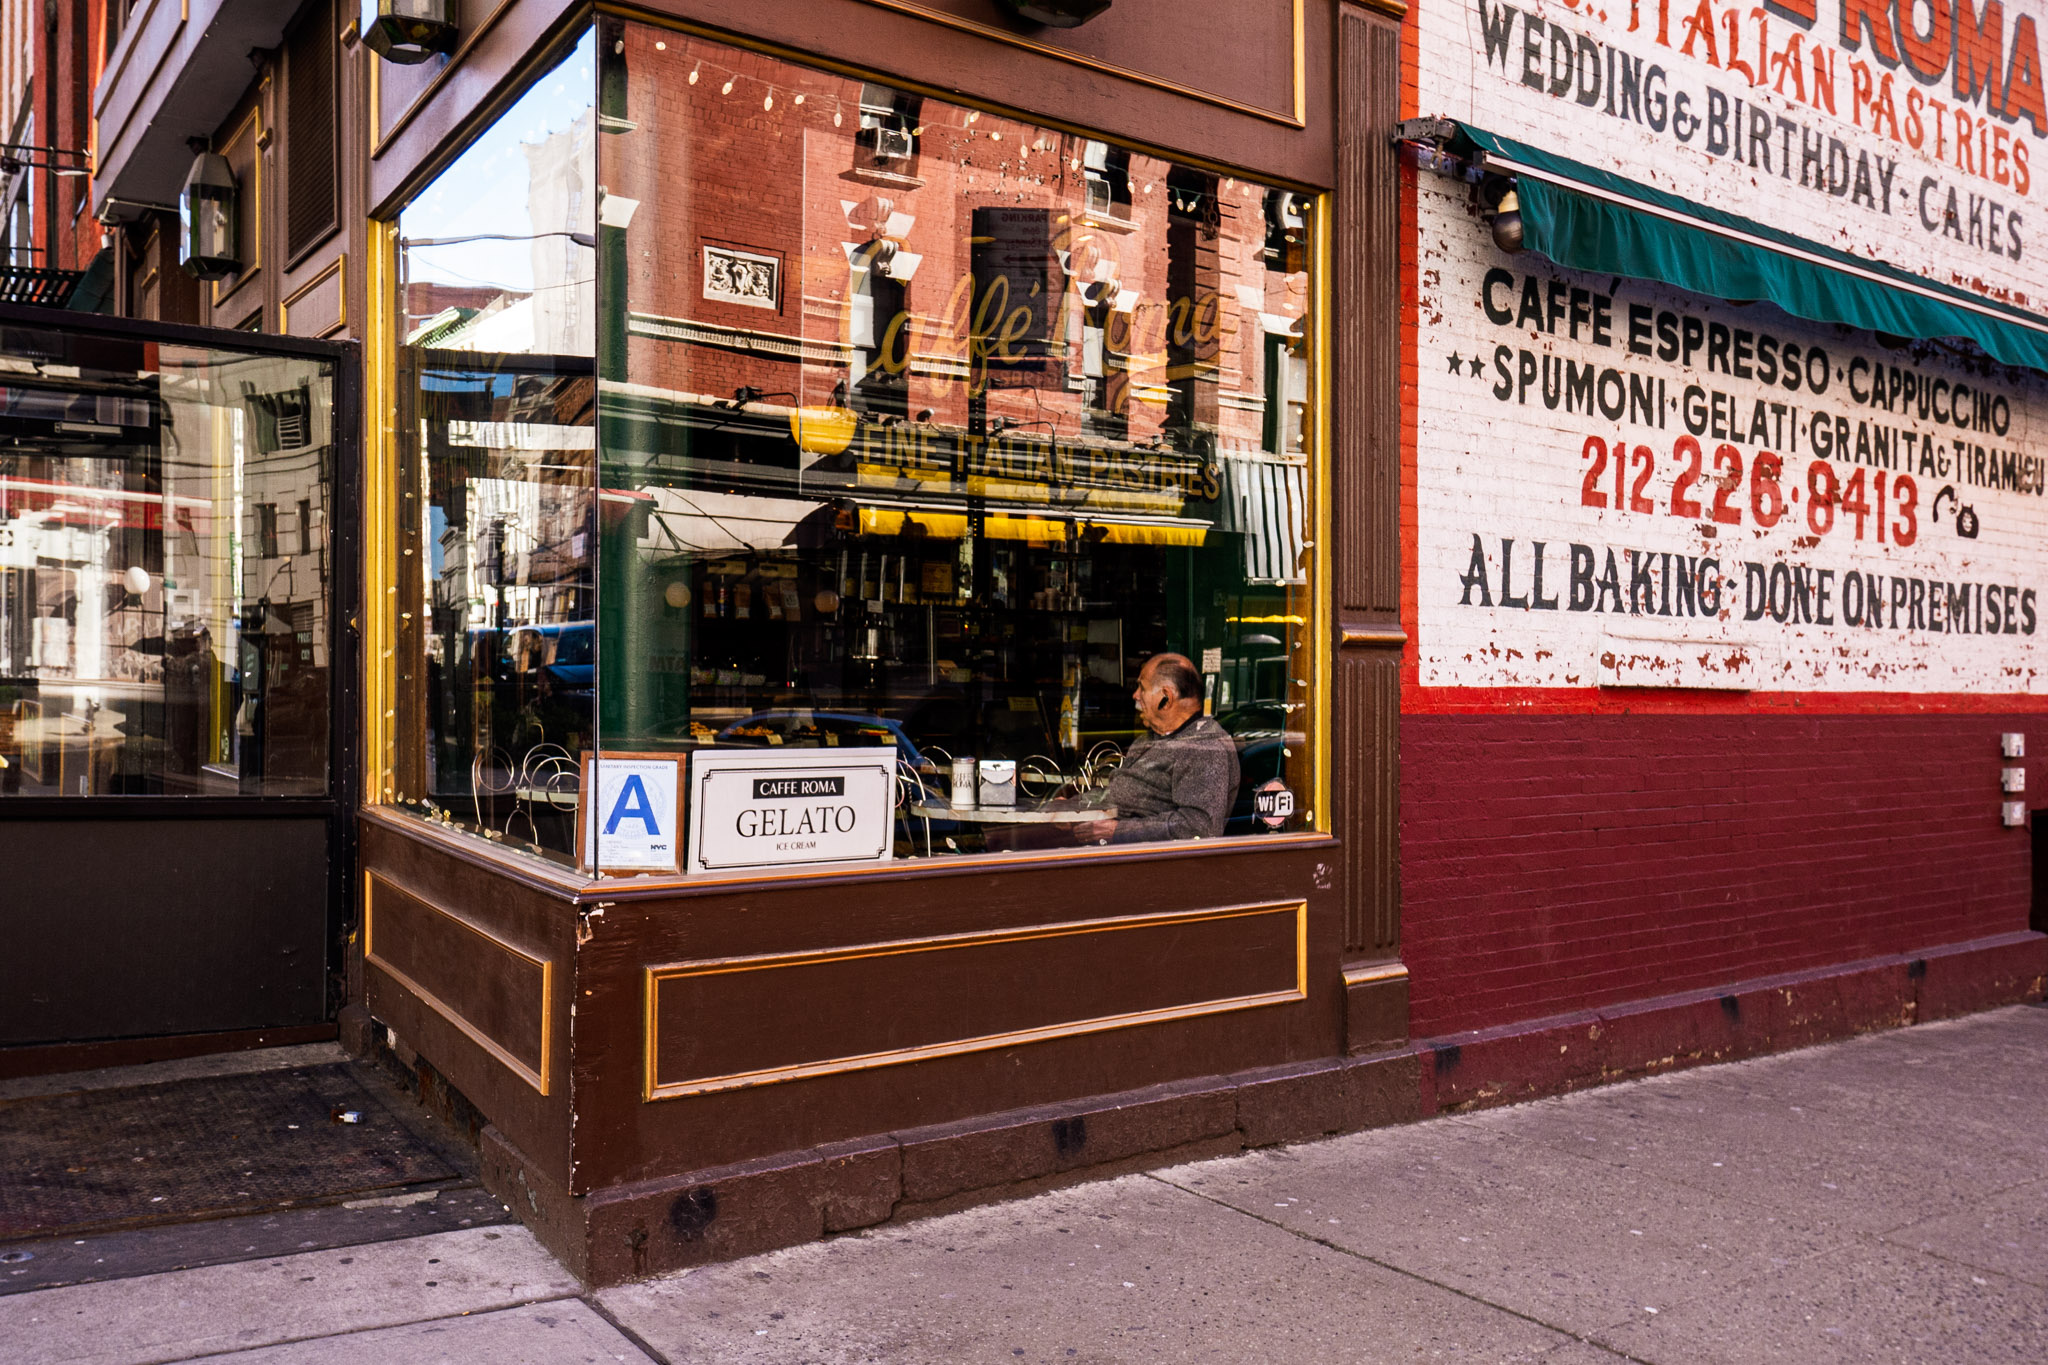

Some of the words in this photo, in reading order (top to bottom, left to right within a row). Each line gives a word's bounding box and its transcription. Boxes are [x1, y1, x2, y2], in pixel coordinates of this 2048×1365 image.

[1478, 0, 1667, 133] WEDDING
[1706, 85, 1898, 216] BIRTHDAY
[1918, 175, 2023, 261] CAKES
[1848, 55, 2030, 196] PASTRIES
[1629, 303, 1830, 395] ESPRESSO
[1849, 356, 2010, 436] CAPPUCCINO
[1492, 344, 1666, 429] SPUMONI
[1683, 384, 1796, 452] GELATI
[1810, 411, 1937, 478] GRANITA
[862, 423, 940, 470] FINE
[956, 433, 1074, 482] ITALIAN
[1090, 448, 1221, 500] PASTRIES
[1581, 435, 1655, 515] 212
[1458, 533, 1559, 611] ALL
[1567, 542, 1721, 618] BAKING
[1743, 561, 1834, 626] DONE
[1842, 570, 1884, 629] ON
[1889, 576, 2037, 636] PREMISES
[602, 774, 660, 836] A
[735, 805, 856, 838] GELATO
[759, 781, 798, 796] CAFFE
[801, 780, 837, 795] ROMA
[776, 842, 789, 851] ICE
[790, 841, 816, 850] CREAM
